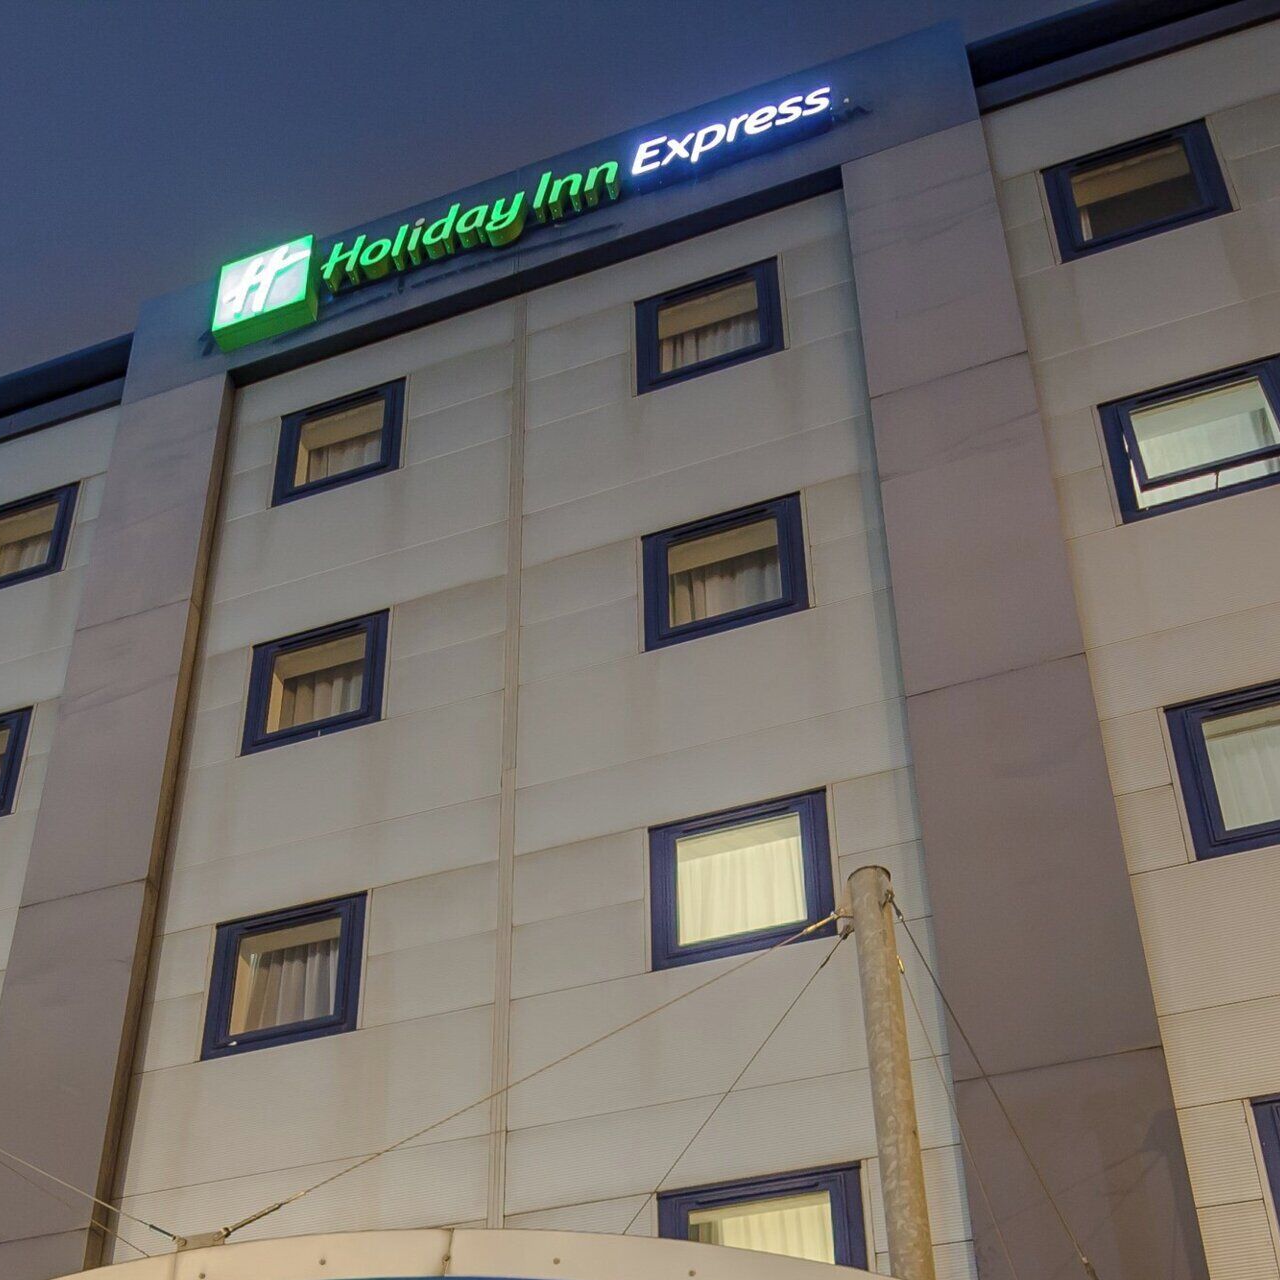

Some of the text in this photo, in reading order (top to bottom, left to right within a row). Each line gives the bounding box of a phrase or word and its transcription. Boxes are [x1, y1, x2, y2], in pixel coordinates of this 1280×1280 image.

[320, 86, 831, 284] Holiday Inn Express
